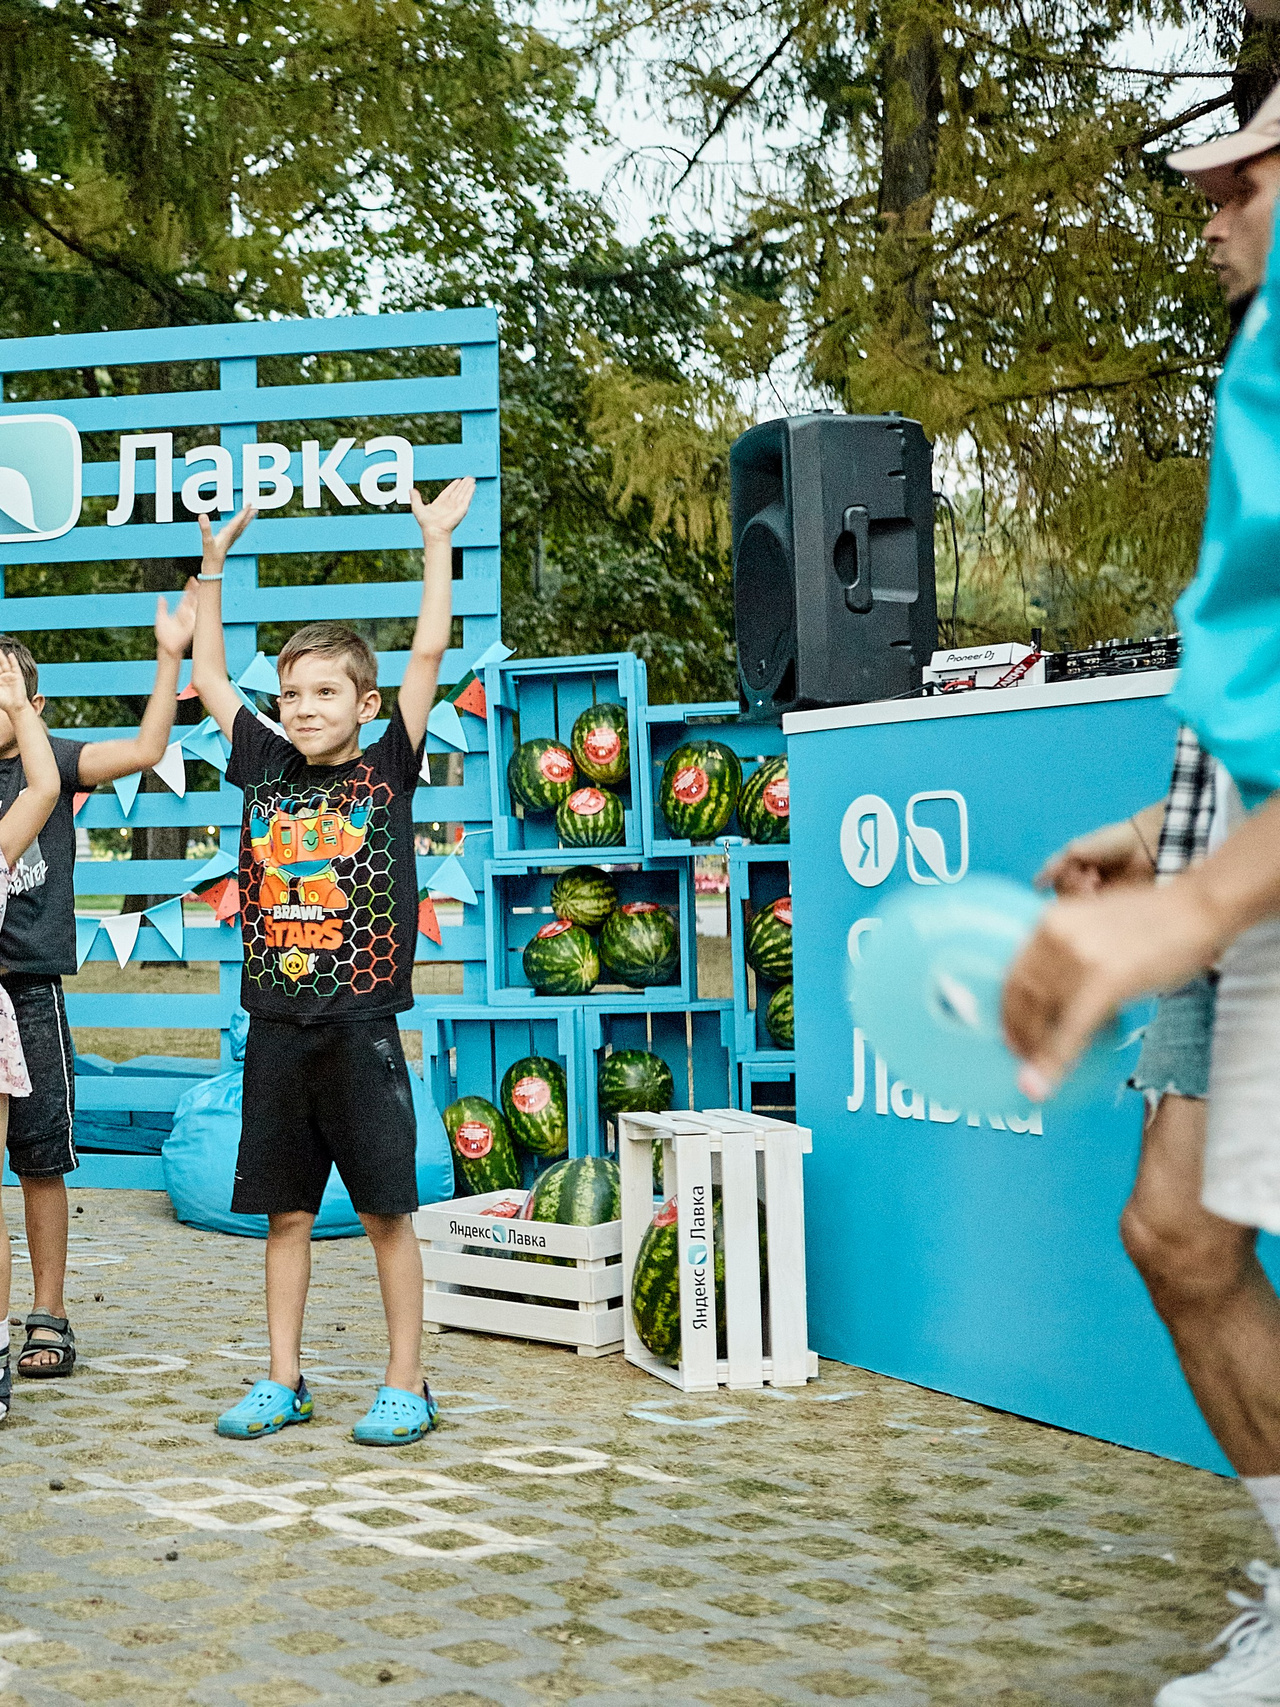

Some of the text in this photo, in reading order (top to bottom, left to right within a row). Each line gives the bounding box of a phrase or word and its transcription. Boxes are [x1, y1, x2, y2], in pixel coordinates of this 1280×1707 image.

[107, 433, 416, 526] Лавка
[947, 654, 983, 663] Pioneer
[273, 905, 325, 921] BRAWL
[266, 916, 344, 950] STARS
[449, 1220, 547, 1248] Яндекс Лавка
[690, 1184, 708, 1331] Яндекс Лавка
